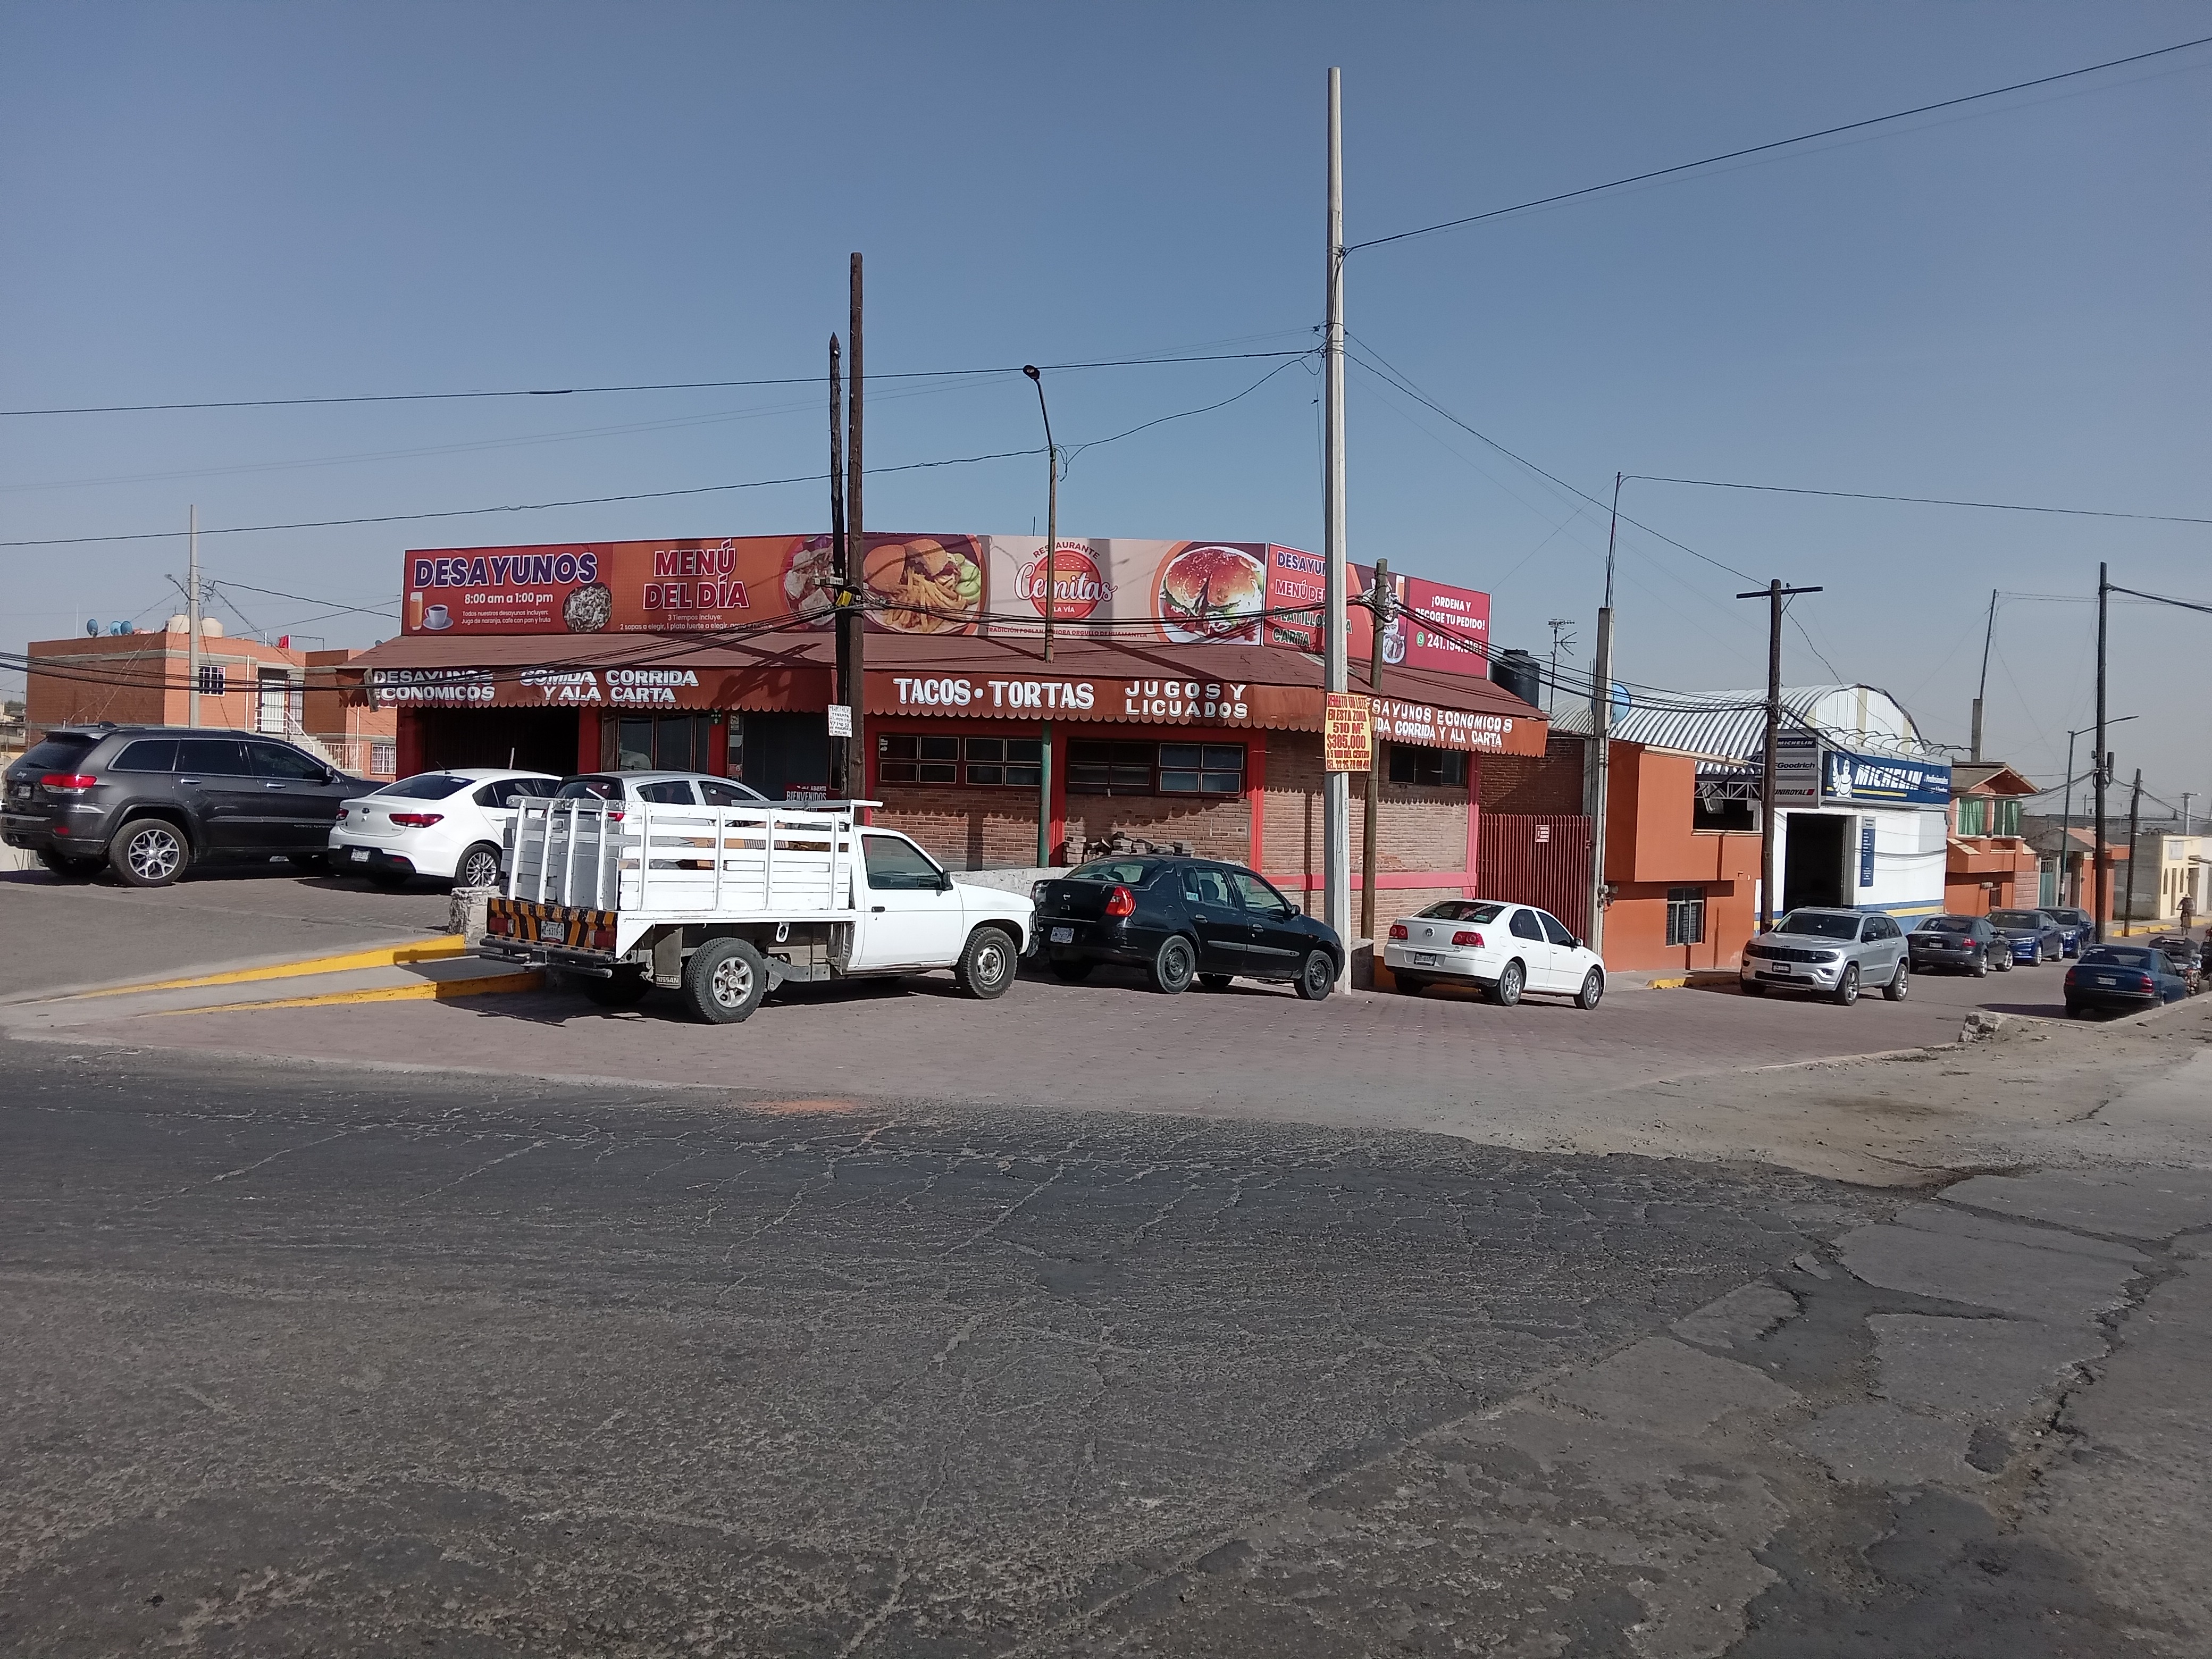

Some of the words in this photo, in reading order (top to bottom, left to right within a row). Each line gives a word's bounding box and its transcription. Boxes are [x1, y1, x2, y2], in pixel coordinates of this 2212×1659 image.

[653, 538, 736, 577] MENÚ
[1033, 541, 1100, 560] RESAURANTE
[414, 552, 598, 589] DESAYUNOS
[1277, 551, 1326, 577] DESAYU
[464, 593, 485, 604] 8:00
[487, 594, 504, 604] am
[515, 592, 534, 603] 1:00
[536, 593, 554, 606] pm
[642, 583, 693, 610] DEL
[696, 574, 750, 609] DÍA
[1275, 579, 1308, 600] MENÚ
[1431, 595, 1465, 611] ¡ORDENA
[1465, 601, 1471, 612] Y
[1273, 605, 1326, 629] PLATILLO
[1446, 614, 1456, 625] TU
[1456, 616, 1485, 631] PEDIDO!
[1272, 627, 1311, 648] CARTA
[605, 670, 699, 686] CORRIDA
[543, 686, 557, 700] Y
[610, 688, 676, 702] CARTA
[893, 678, 971, 706] TACOS
[987, 680, 1095, 709] TORTAS
[1125, 681, 1222, 699] JUGOS
[1229, 684, 1247, 700] Y
[1125, 698, 1249, 719] LICUADOS
[1336, 709, 1352, 721] ESTA
[1352, 710, 1367, 722] ZONA
[1333, 722, 1350, 734] 510
[1437, 710, 1513, 733] ECONOMICOS
[1327, 733, 1366, 750] $385,000
[1395, 720, 1436, 741] CORRIDA
[1439, 726, 1446, 741] Y
[1471, 731, 1502, 748] CARTA
[1330, 749, 1334, 758] 5
[1854, 764, 1923, 791] MICHELIN
[786, 791, 827, 801] BIENVENIDOS
